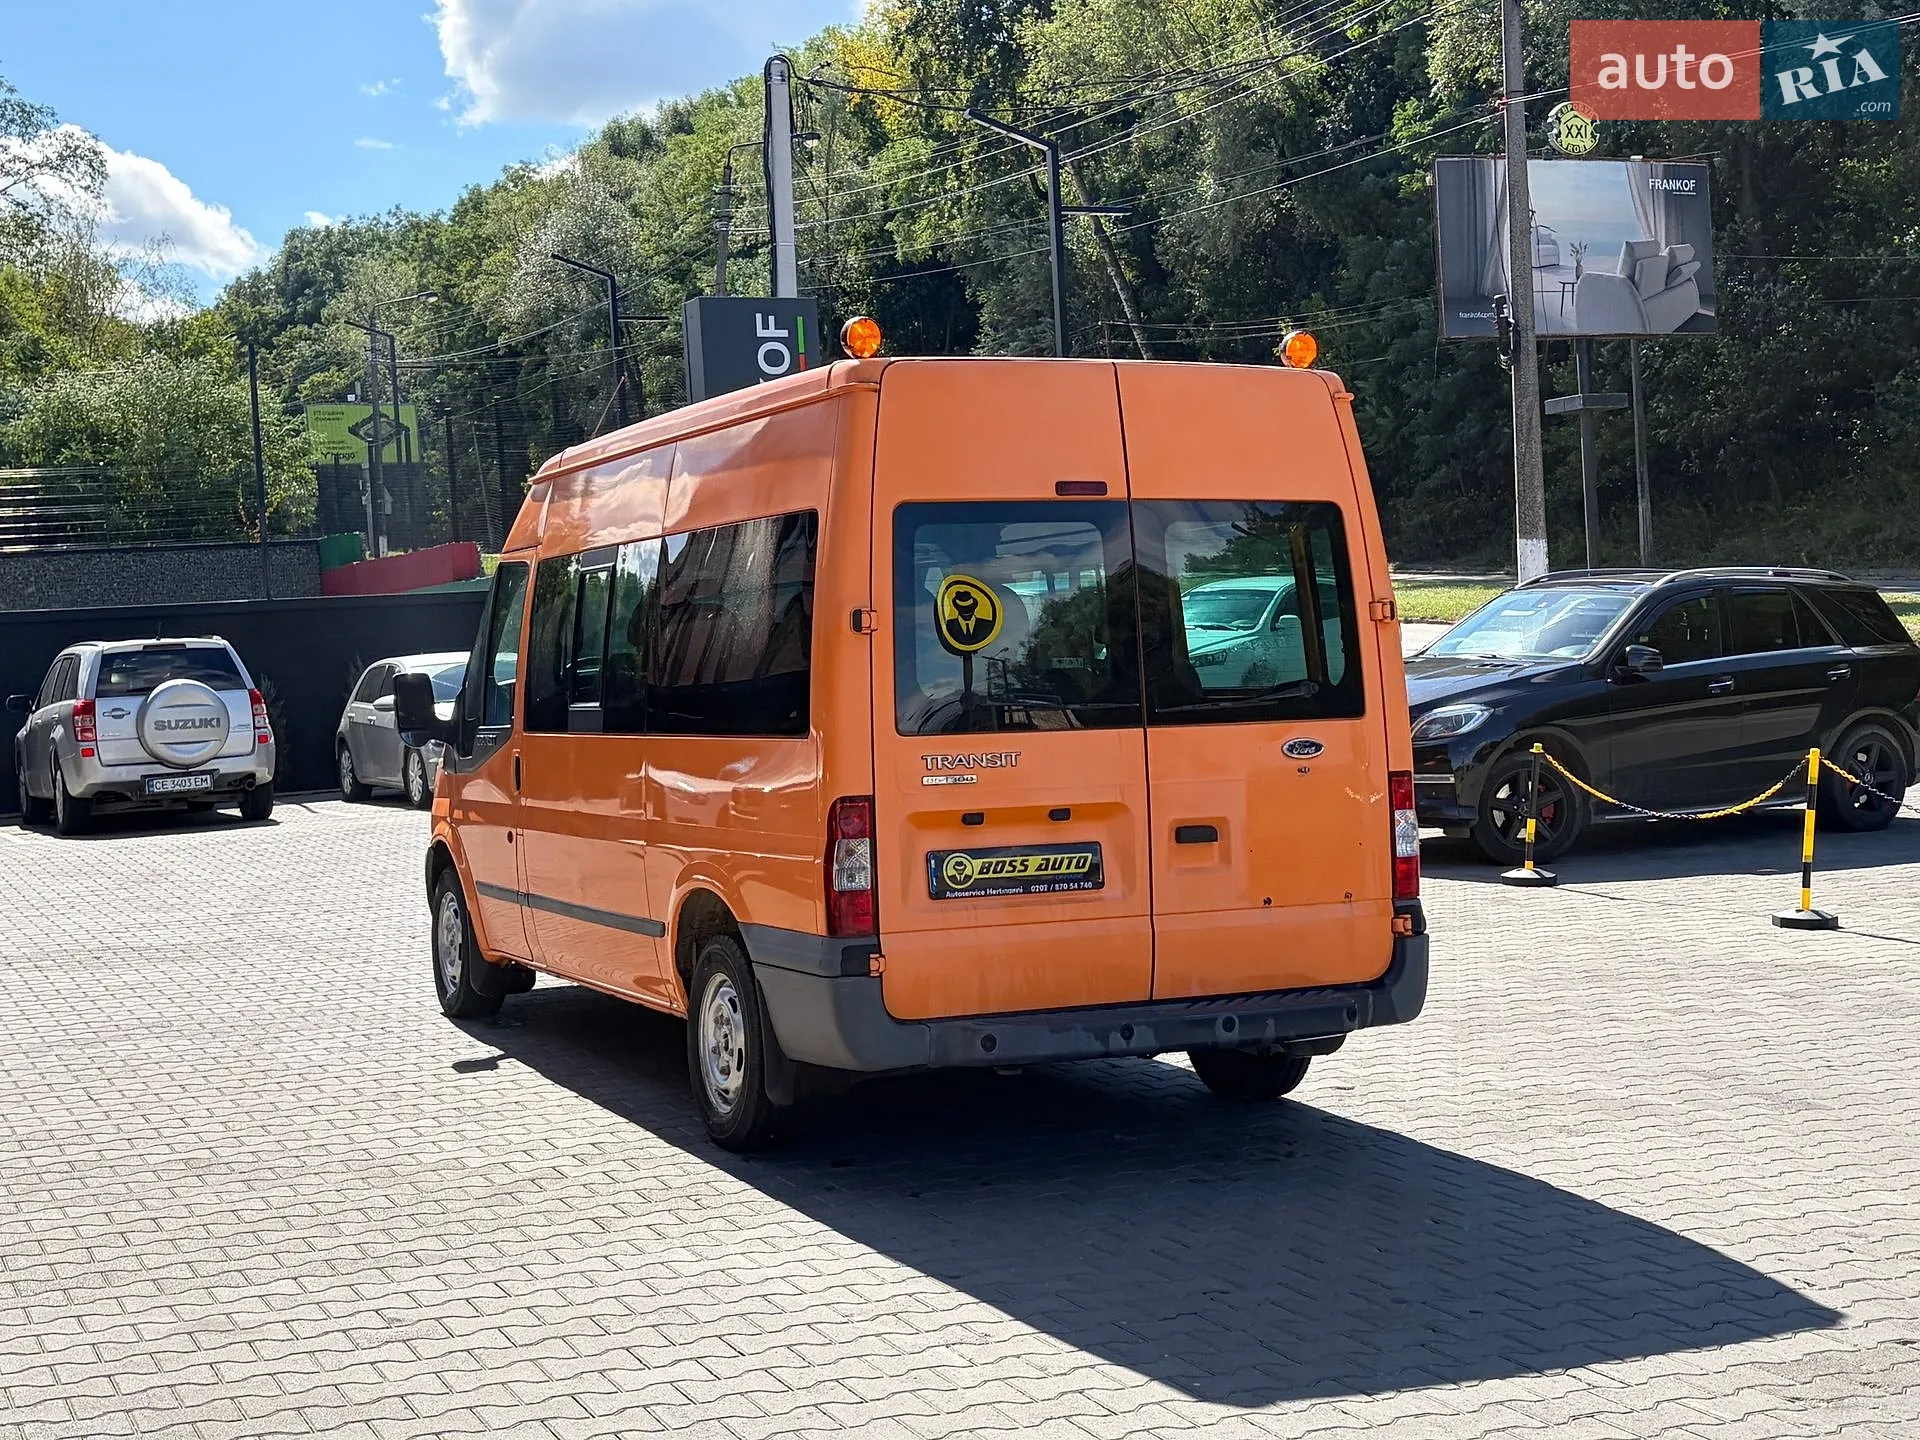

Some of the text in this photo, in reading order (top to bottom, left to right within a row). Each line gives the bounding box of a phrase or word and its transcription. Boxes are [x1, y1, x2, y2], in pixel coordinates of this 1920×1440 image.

[1565, 124, 1588, 139] XXI
[1648, 178, 1696, 191] FRANKOF
[755, 312, 791, 383] OF
[153, 717, 221, 732] SUZUKI
[1292, 742, 1316, 754] Ford
[921, 752, 1021, 770] TRANSIT
[154, 775, 209, 791] CE 3403 EM
[978, 855, 1090, 876] BOSS AUTO
[946, 888, 986, 898] Autoservice
[1079, 881, 1093, 889] 740
